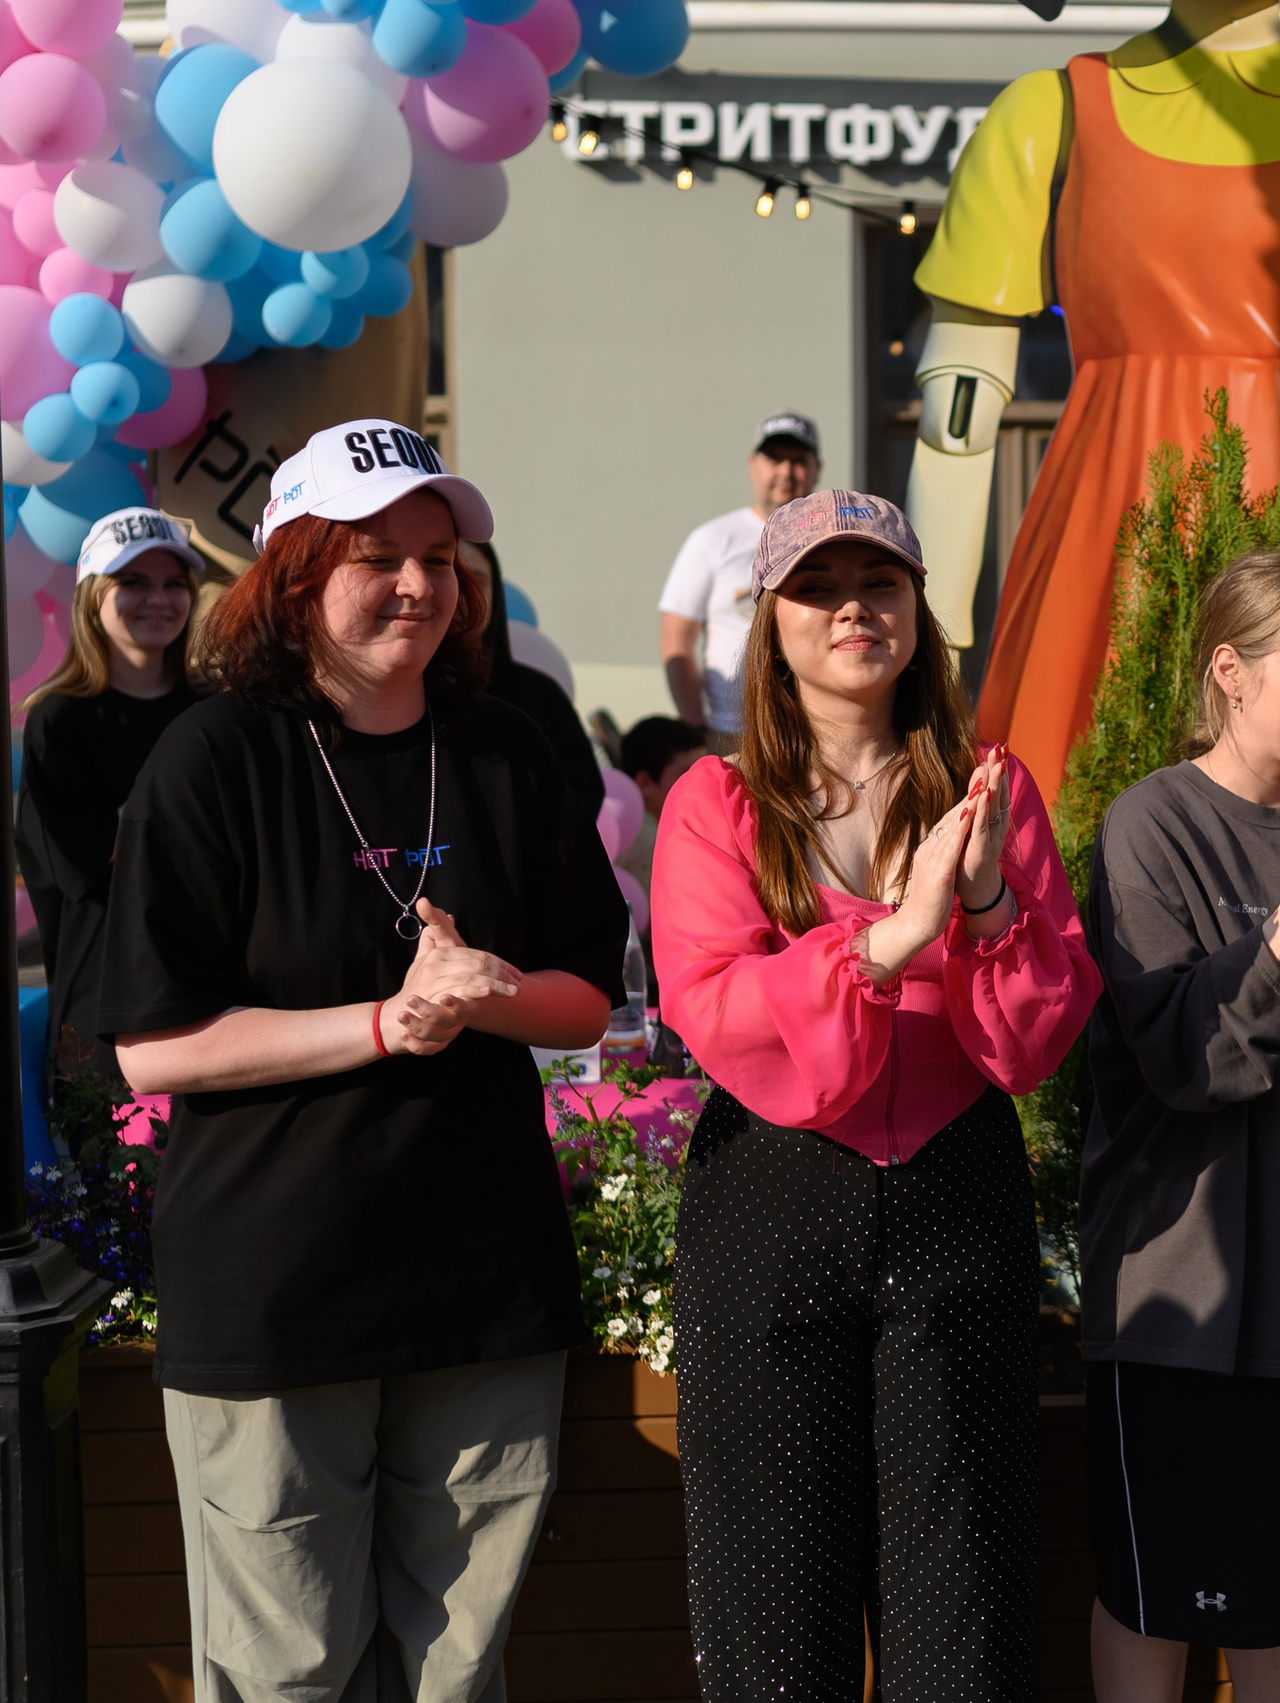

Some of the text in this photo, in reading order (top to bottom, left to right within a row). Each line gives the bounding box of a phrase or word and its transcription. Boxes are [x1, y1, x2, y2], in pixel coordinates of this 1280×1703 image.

[283, 480, 306, 505] POT
[797, 506, 874, 530] HOT POT
[353, 845, 451, 870] HOT POT
[1242, 903, 1269, 916] Energy
